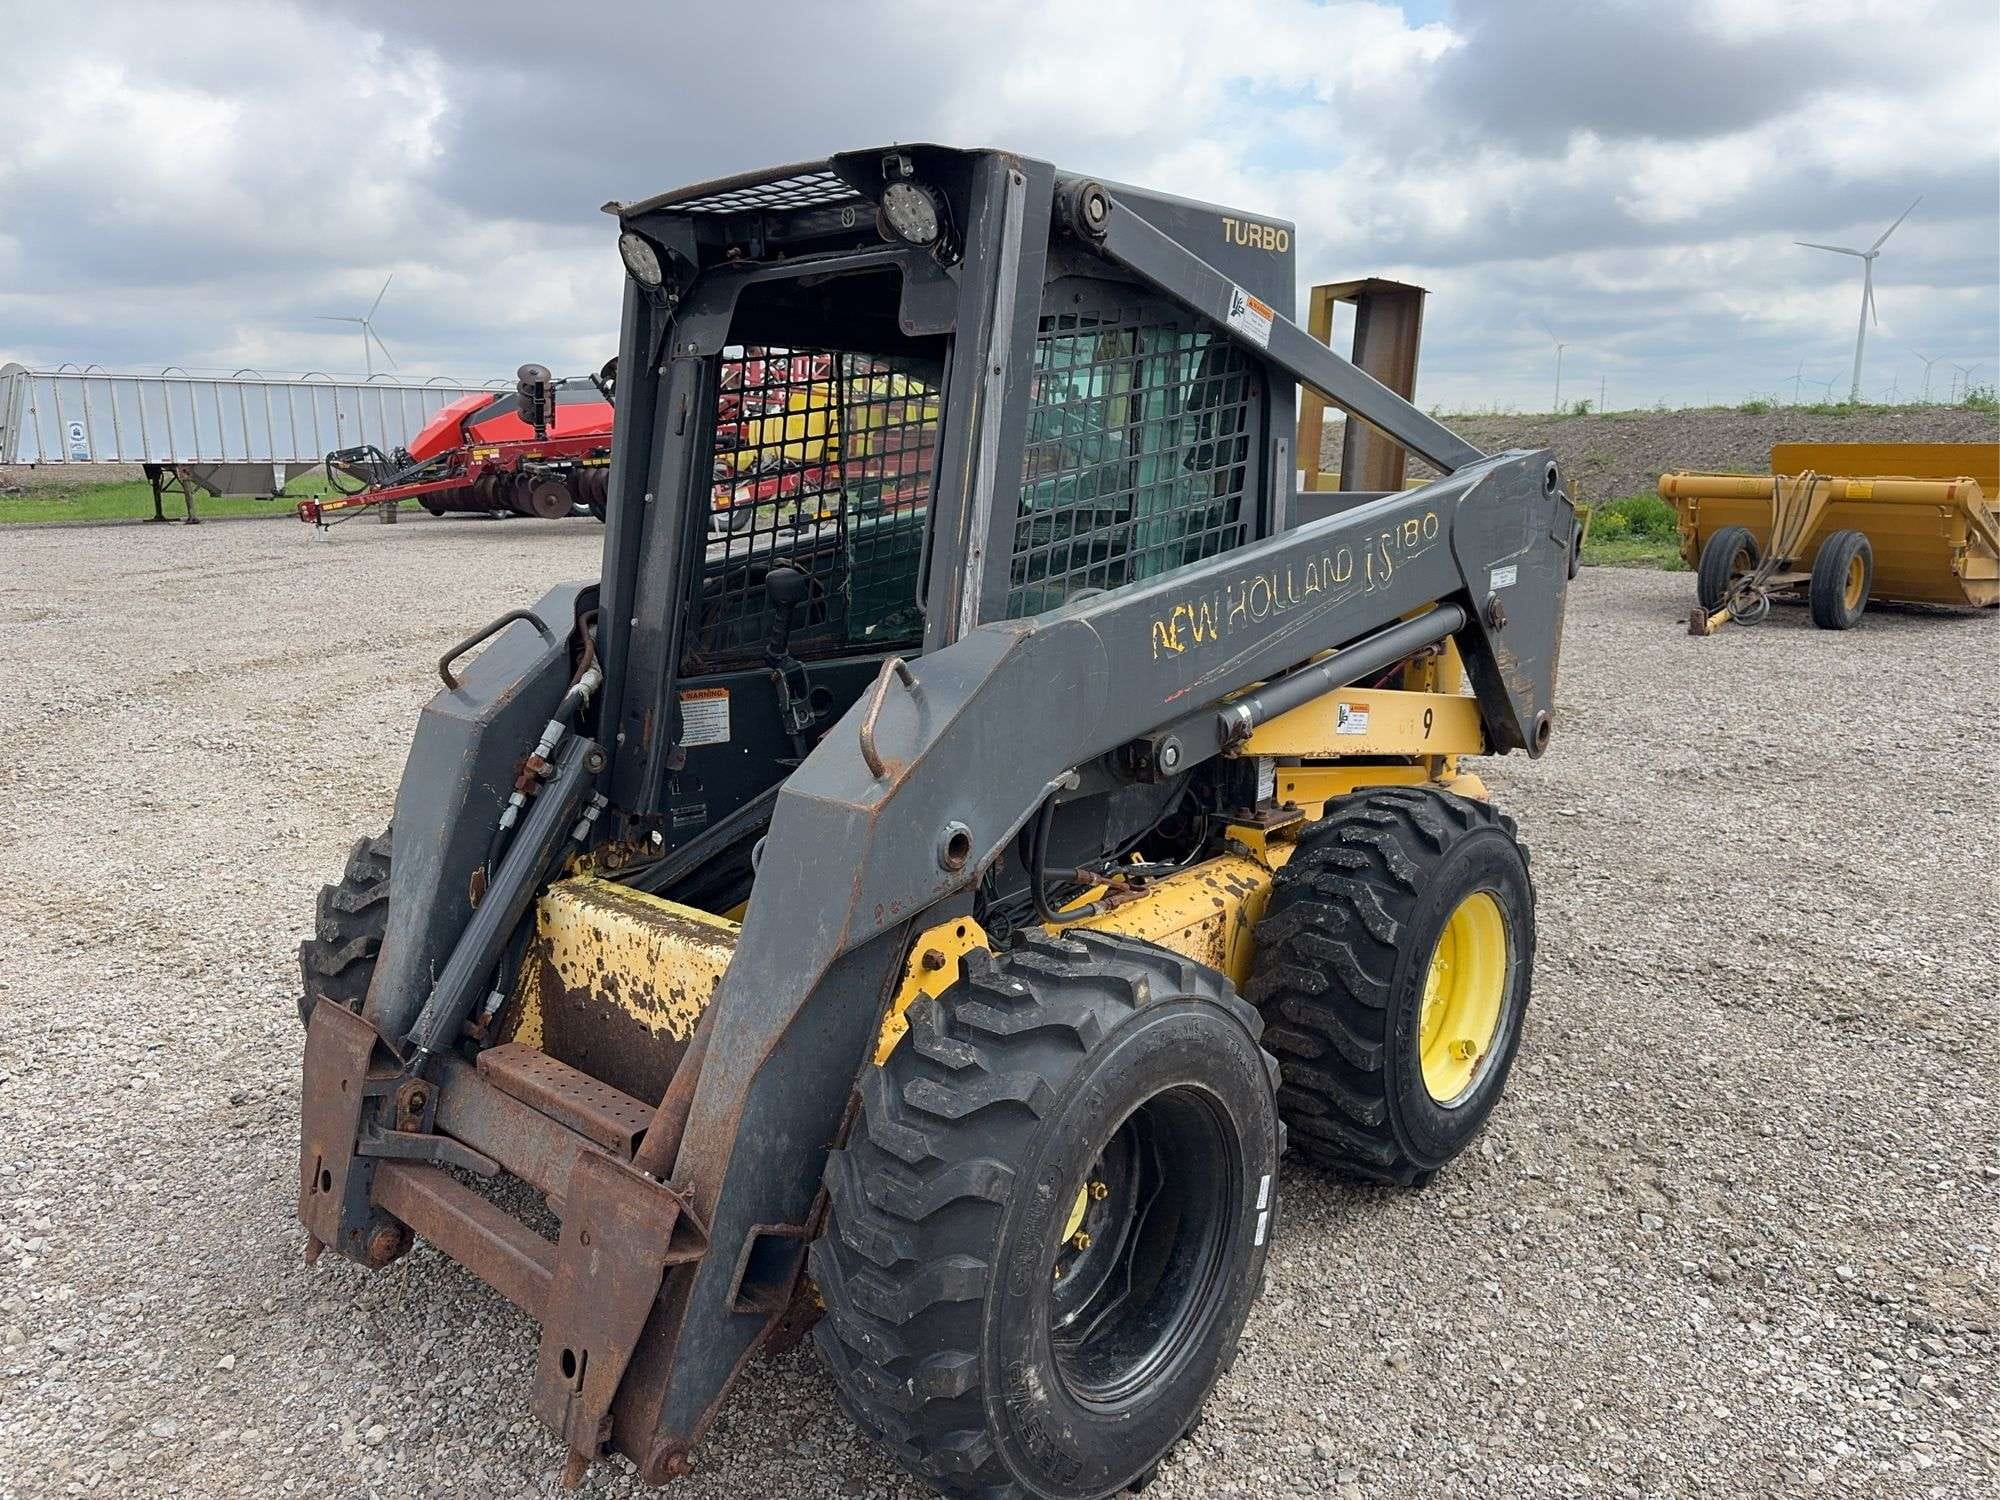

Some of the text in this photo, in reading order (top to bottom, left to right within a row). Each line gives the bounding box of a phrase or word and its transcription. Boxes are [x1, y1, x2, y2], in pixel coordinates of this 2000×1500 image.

[1222, 217, 1290, 253] TURBO
[1152, 594, 1218, 661] NEW
[1226, 547, 1353, 626] HOLLAND
[685, 690, 723, 701] WARNING
[1423, 707, 1434, 740] 9
